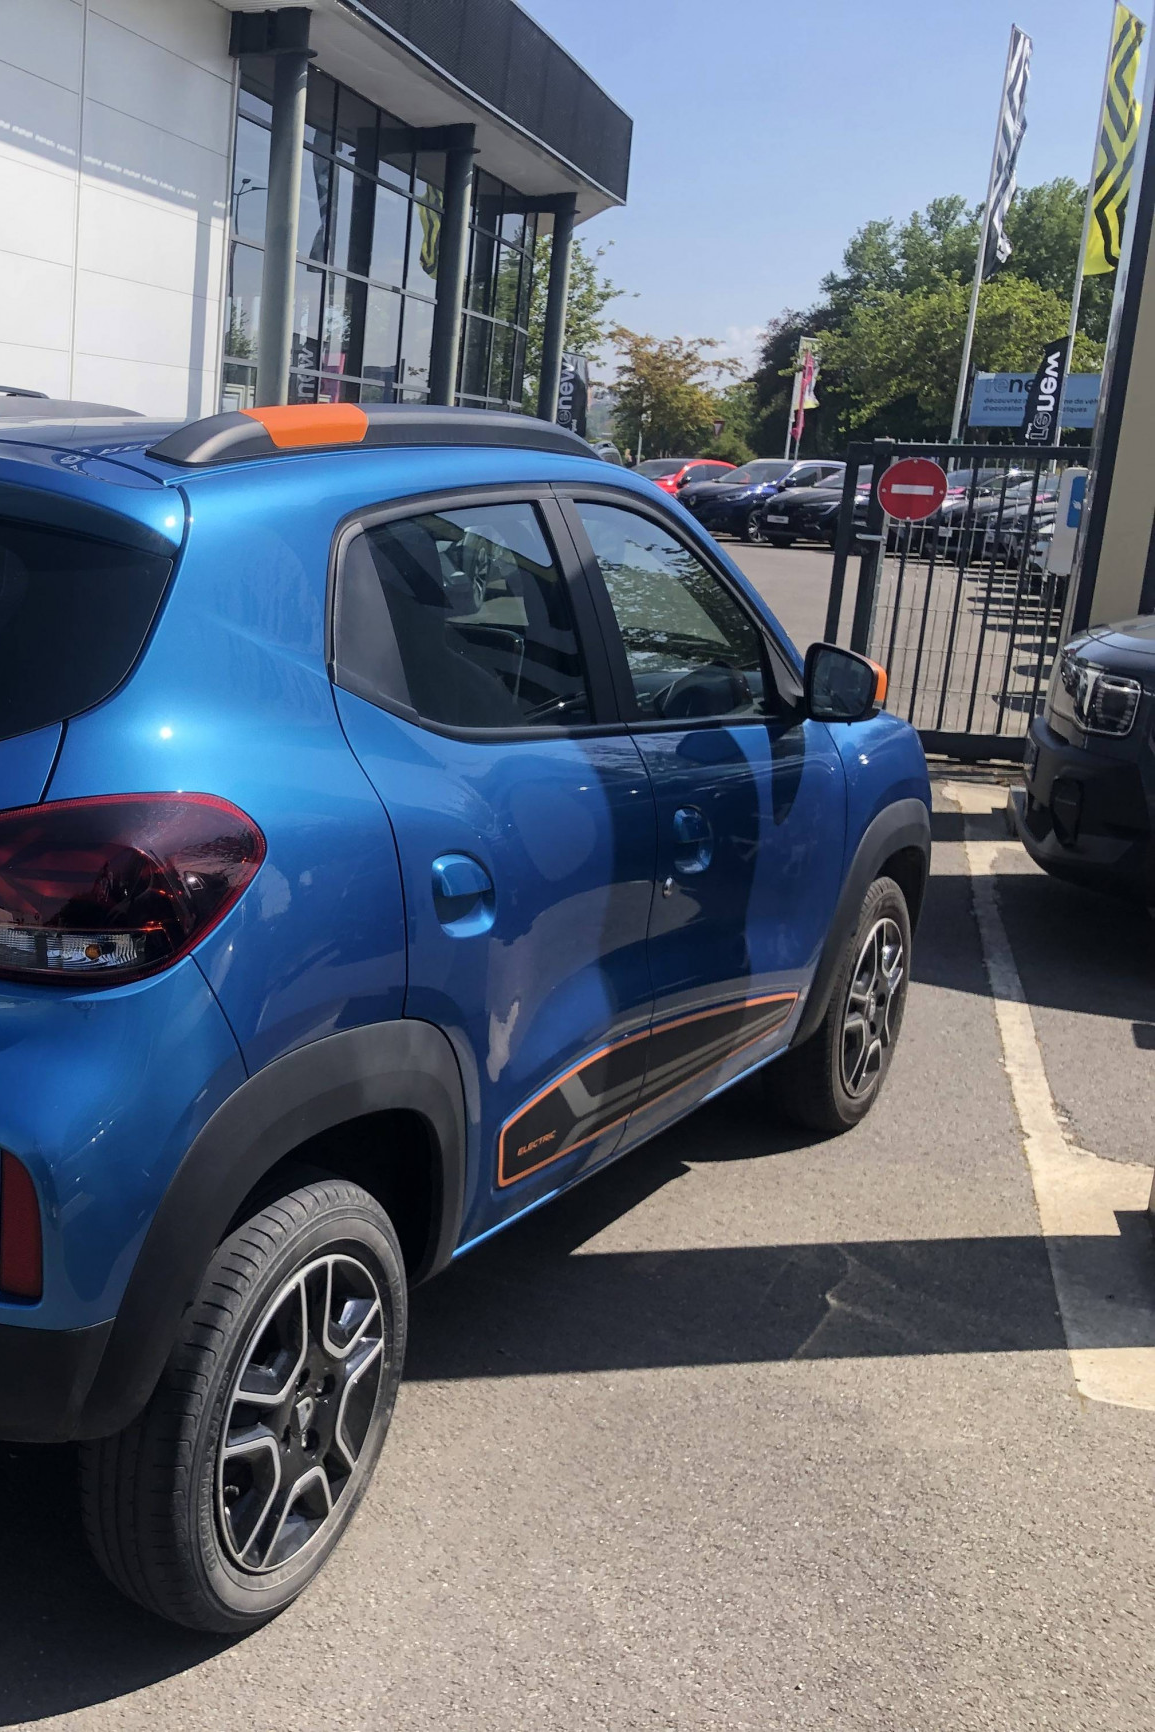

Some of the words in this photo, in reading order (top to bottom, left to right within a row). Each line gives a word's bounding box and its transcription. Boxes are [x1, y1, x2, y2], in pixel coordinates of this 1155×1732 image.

[556, 361, 576, 427] enew
[984, 378, 1036, 394] rene
[517, 1129, 557, 1157] ELECTRIC
